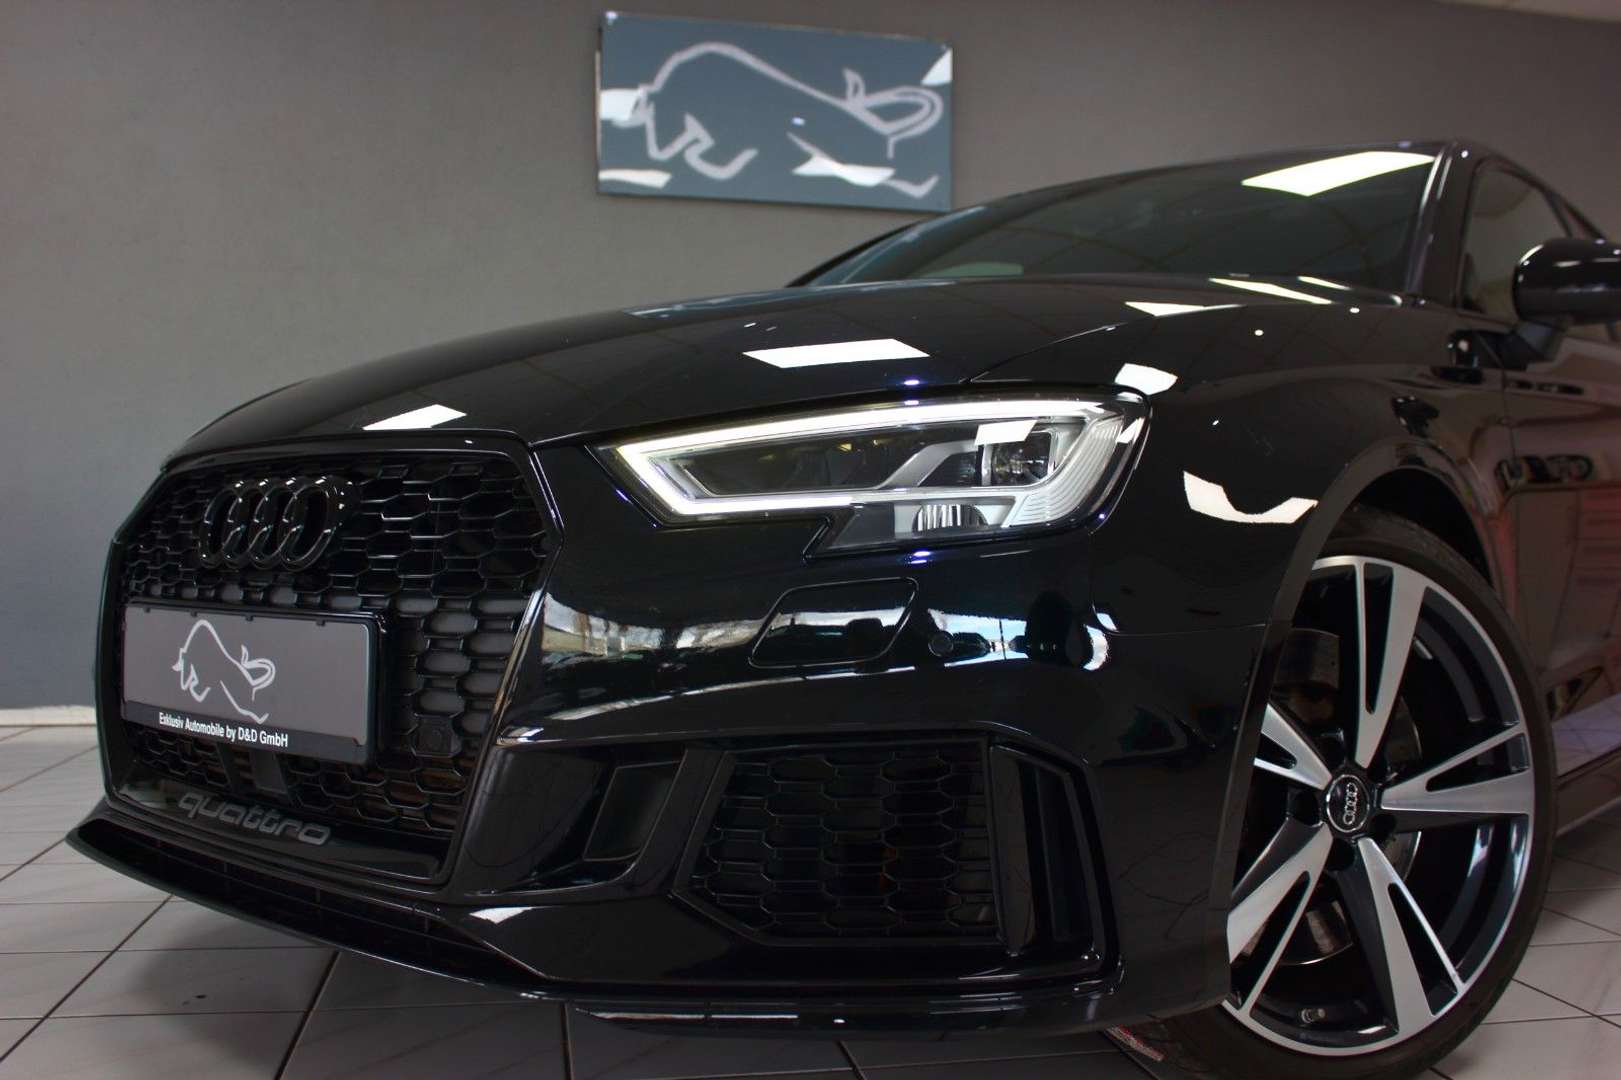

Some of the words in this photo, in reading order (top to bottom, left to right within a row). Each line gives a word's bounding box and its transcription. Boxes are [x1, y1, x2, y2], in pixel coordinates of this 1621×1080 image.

[159, 712, 184, 729] Exklusiv
[185, 717, 225, 737] Automobile
[226, 725, 236, 742] by
[238, 727, 258, 742] D&D
[260, 731, 288, 747] GmbH
[177, 791, 332, 846] quattro
